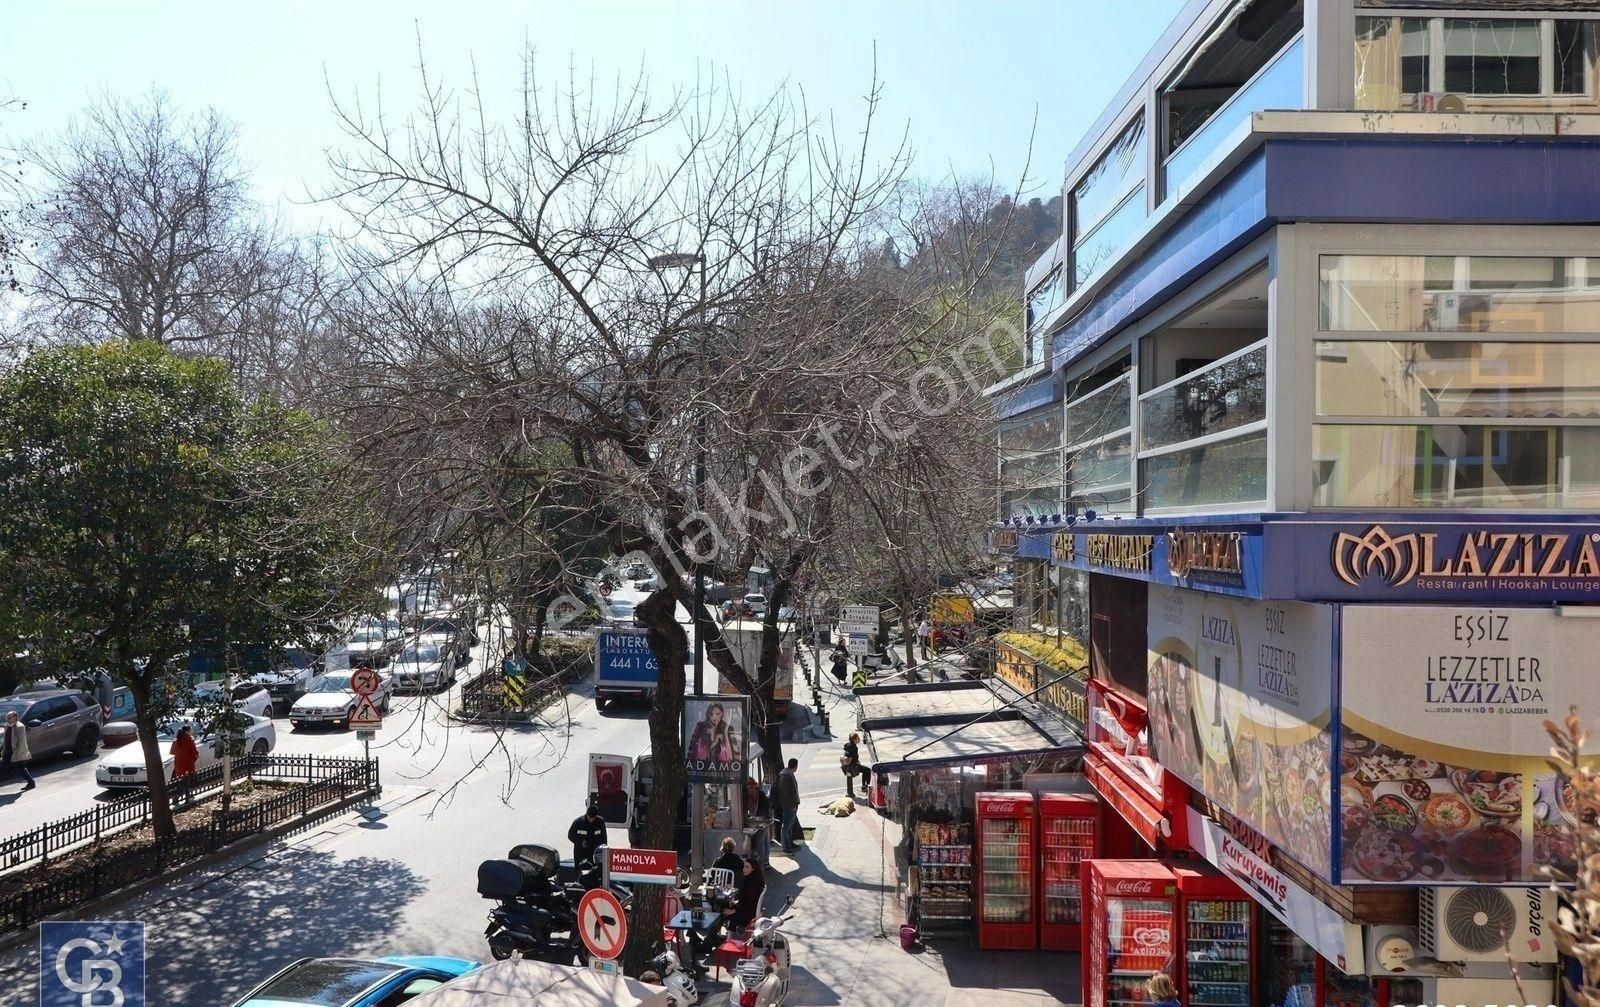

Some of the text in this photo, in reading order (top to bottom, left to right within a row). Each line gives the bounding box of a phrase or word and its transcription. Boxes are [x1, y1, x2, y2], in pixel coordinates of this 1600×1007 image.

[1053, 532, 1076, 560] CAFE
[1086, 534, 1154, 570] RESTAURANT
[1499, 579, 1547, 590] Hookah
[1551, 580, 1600, 593] Lounge
[1454, 610, 1509, 648] EŞSİZ
[610, 657, 631, 669] 444
[636, 657, 640, 669] 1
[1258, 644, 1297, 677] LEZZETLER
[1427, 656, 1542, 682] LEZZETLER
[686, 760, 741, 771] ADAMO
[612, 853, 657, 865] MANOLYA
[1222, 836, 1288, 902] Kuruyemiş
